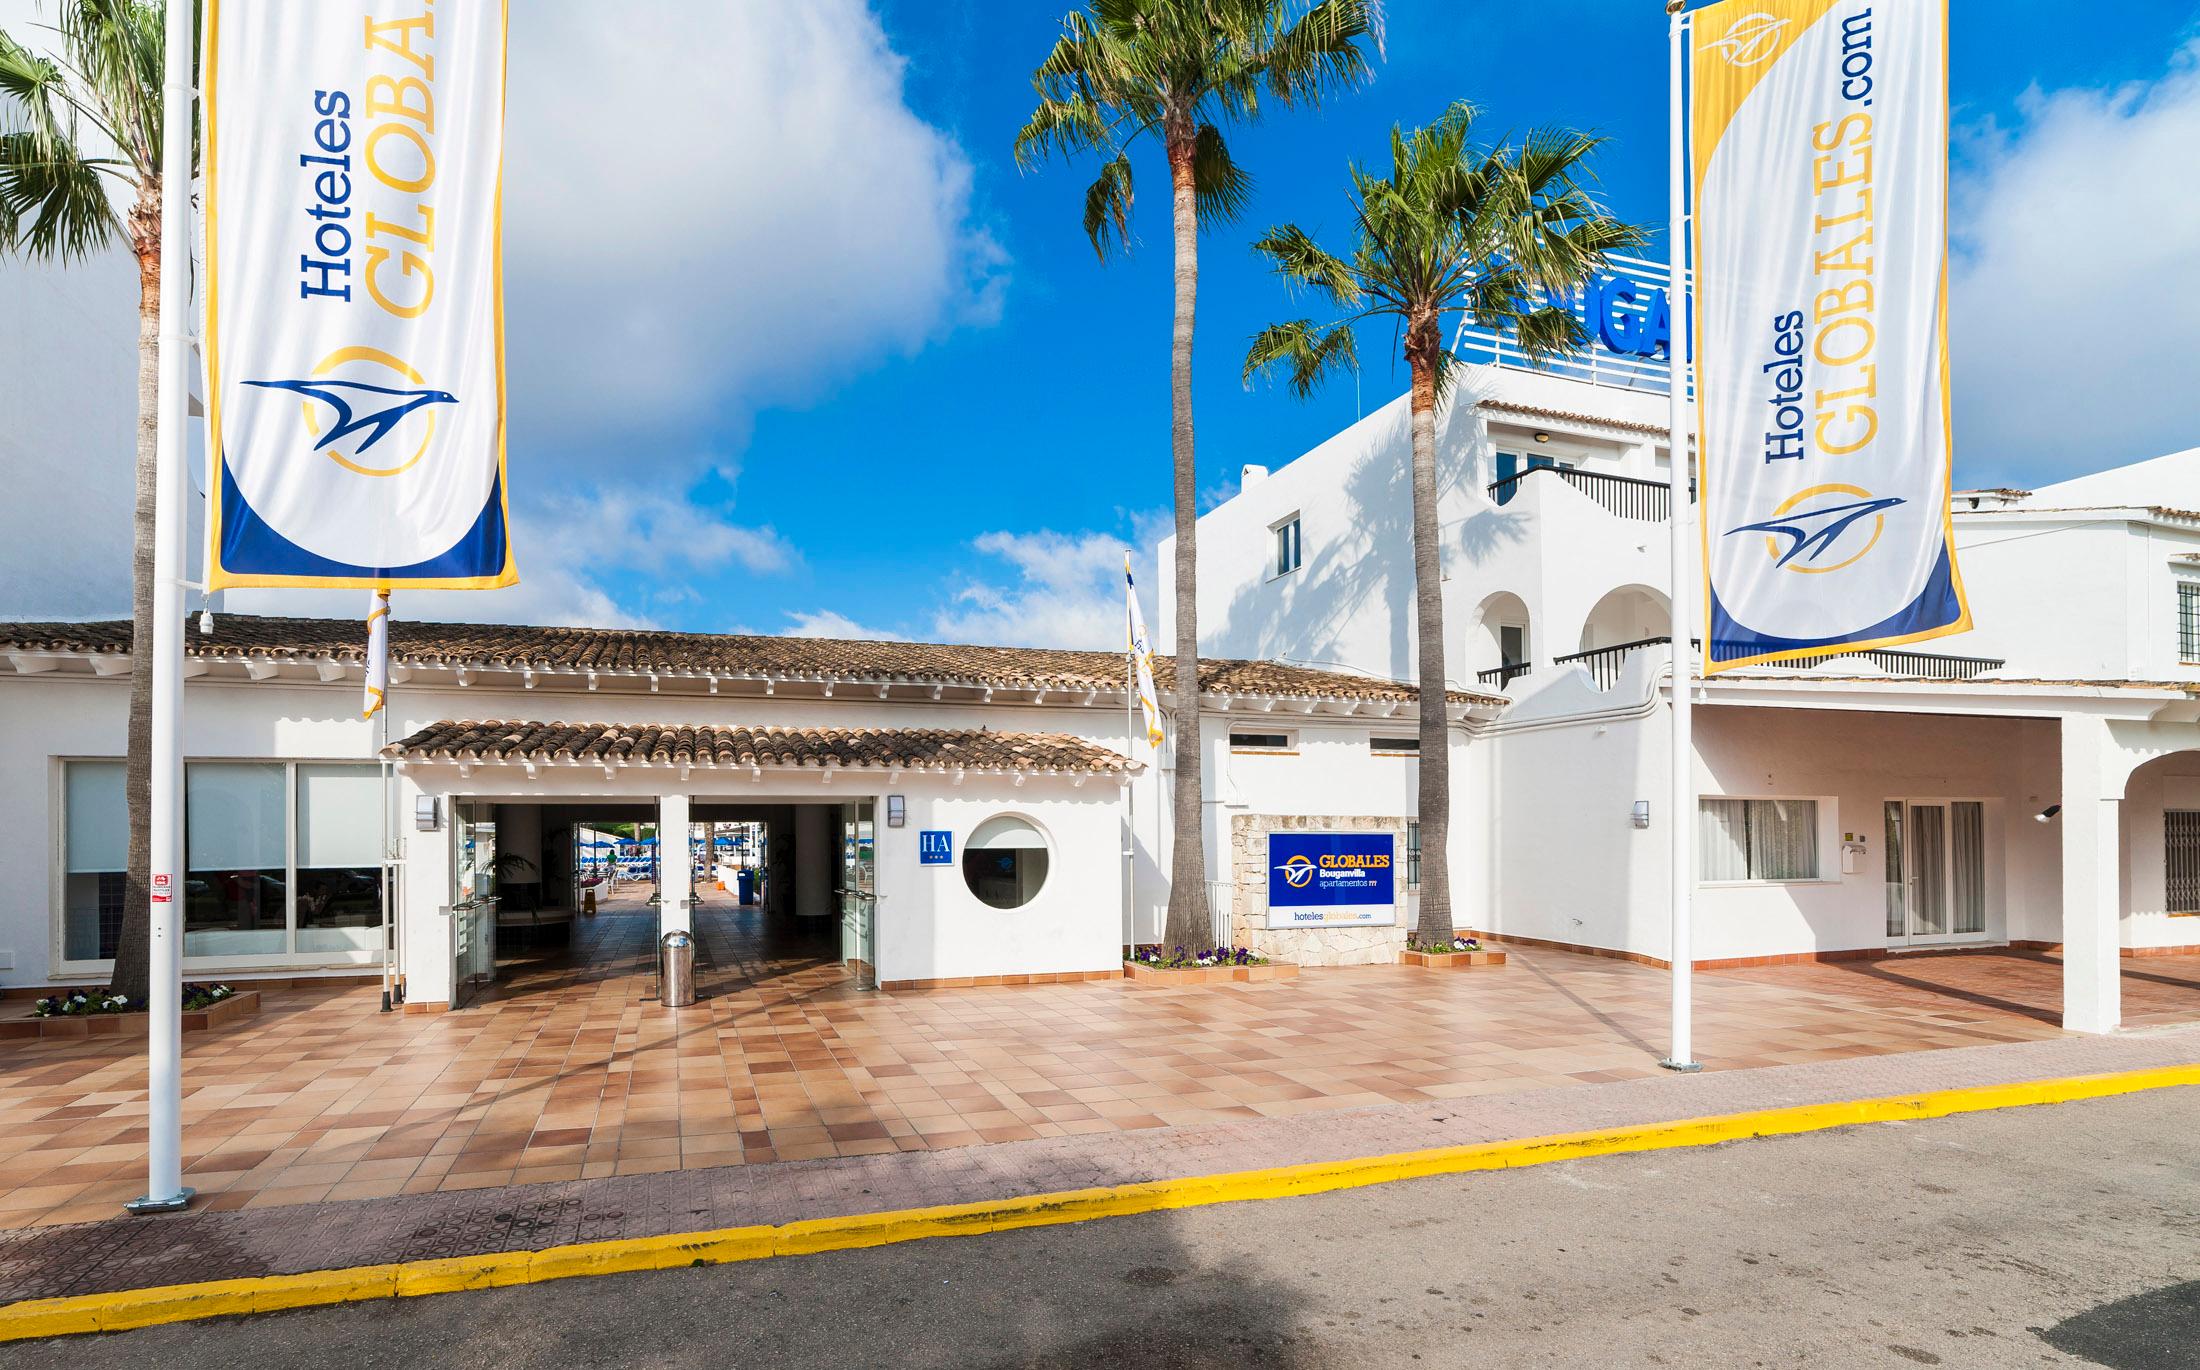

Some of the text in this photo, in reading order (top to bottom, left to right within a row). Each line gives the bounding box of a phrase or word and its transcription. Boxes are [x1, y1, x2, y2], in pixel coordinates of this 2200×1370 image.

[300, 89, 352, 303] Hoteles
[364, 0, 436, 319] GLOBA
[1812, 7, 1879, 455] GLOBALES.com
[1763, 310, 1805, 465] Hoteles
[922, 834, 951, 853] HA
[1319, 854, 1390, 869] GLOBALES
[1319, 868, 1366, 879] Bouganvilla
[1319, 879, 1368, 890] apartamentos
